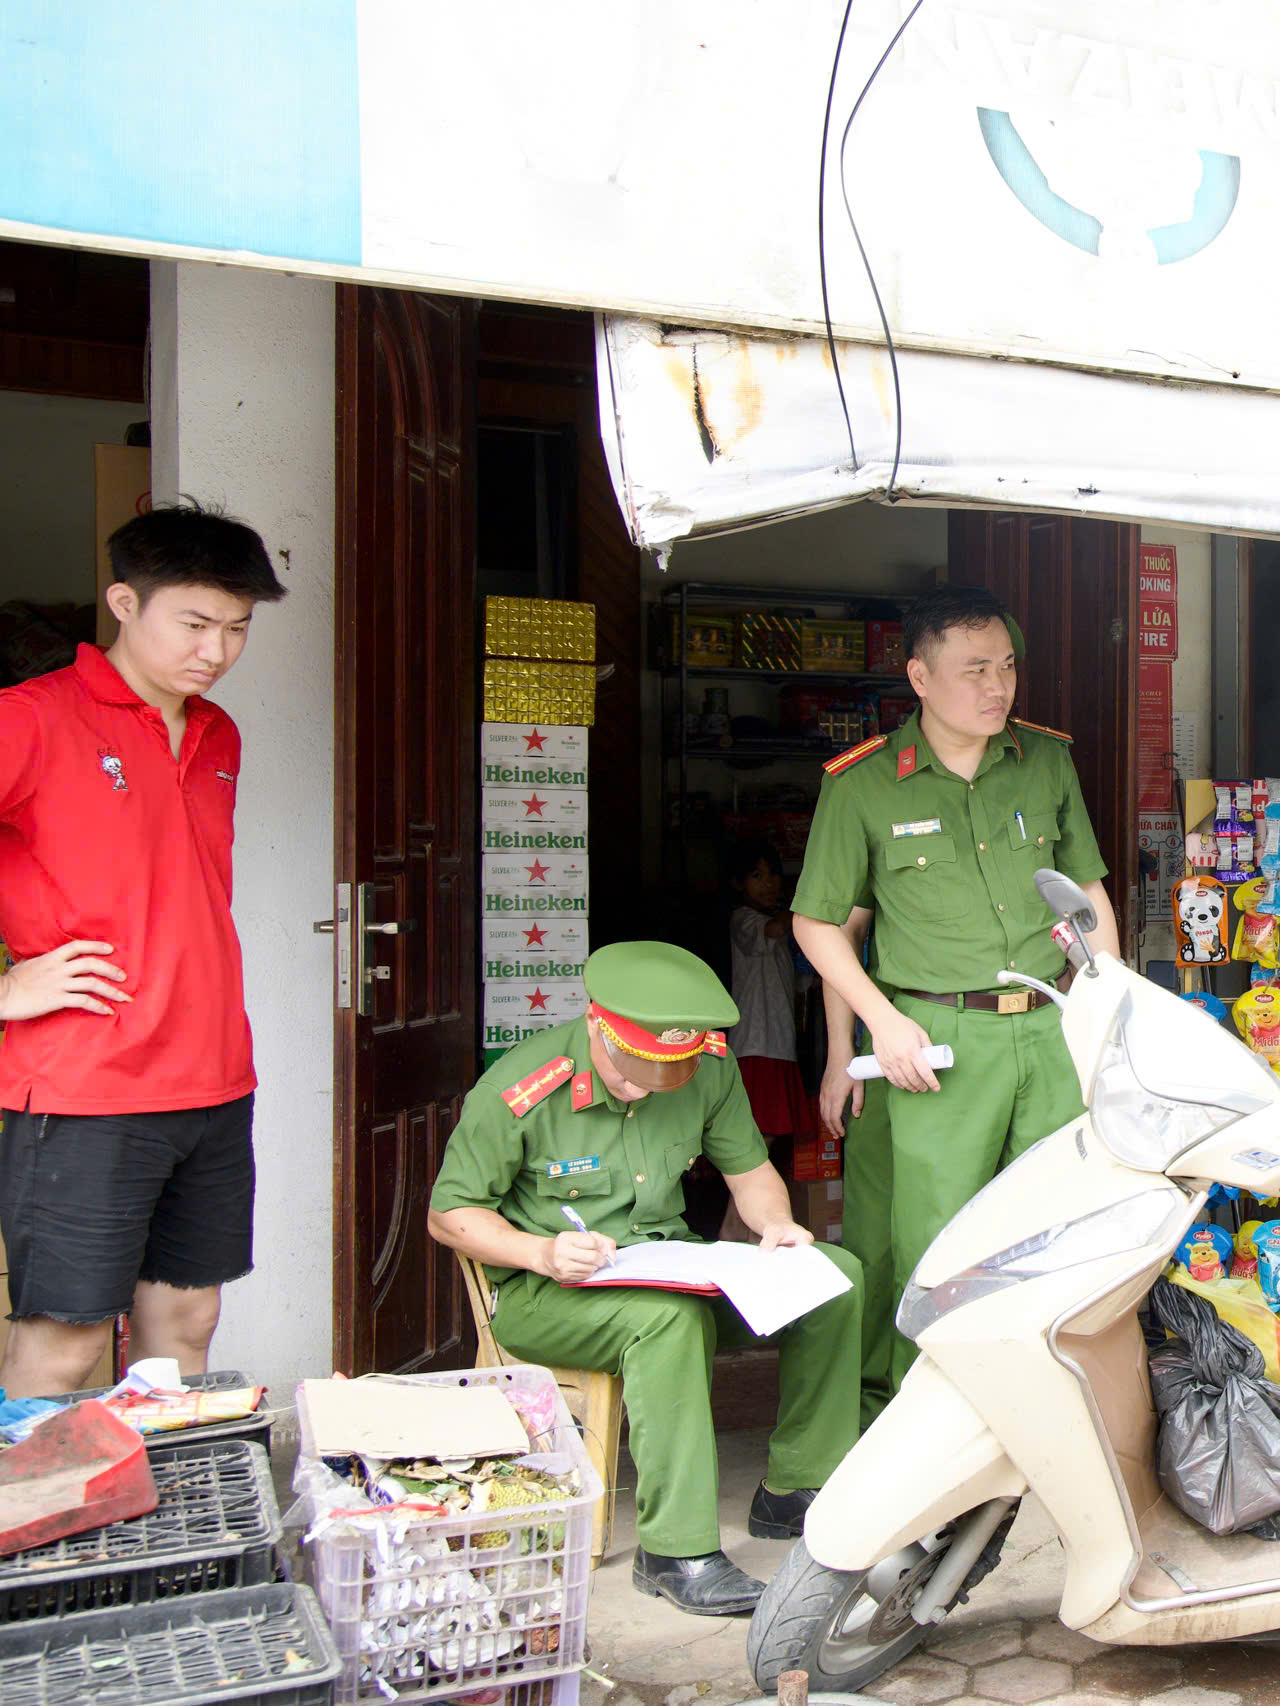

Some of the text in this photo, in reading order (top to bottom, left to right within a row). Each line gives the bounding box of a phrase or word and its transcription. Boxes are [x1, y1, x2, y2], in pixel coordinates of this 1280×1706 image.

[1143, 552, 1171, 571] THUỐC
[1143, 606, 1172, 626] LỬA
[485, 765, 586, 785] Heineken
[485, 831, 586, 849] Heineken
[1141, 837, 1148, 846] 3
[1170, 837, 1177, 847] 4
[485, 894, 587, 911] Heineken
[486, 960, 585, 978] Heineken
[486, 1024, 554, 1043] Hein
